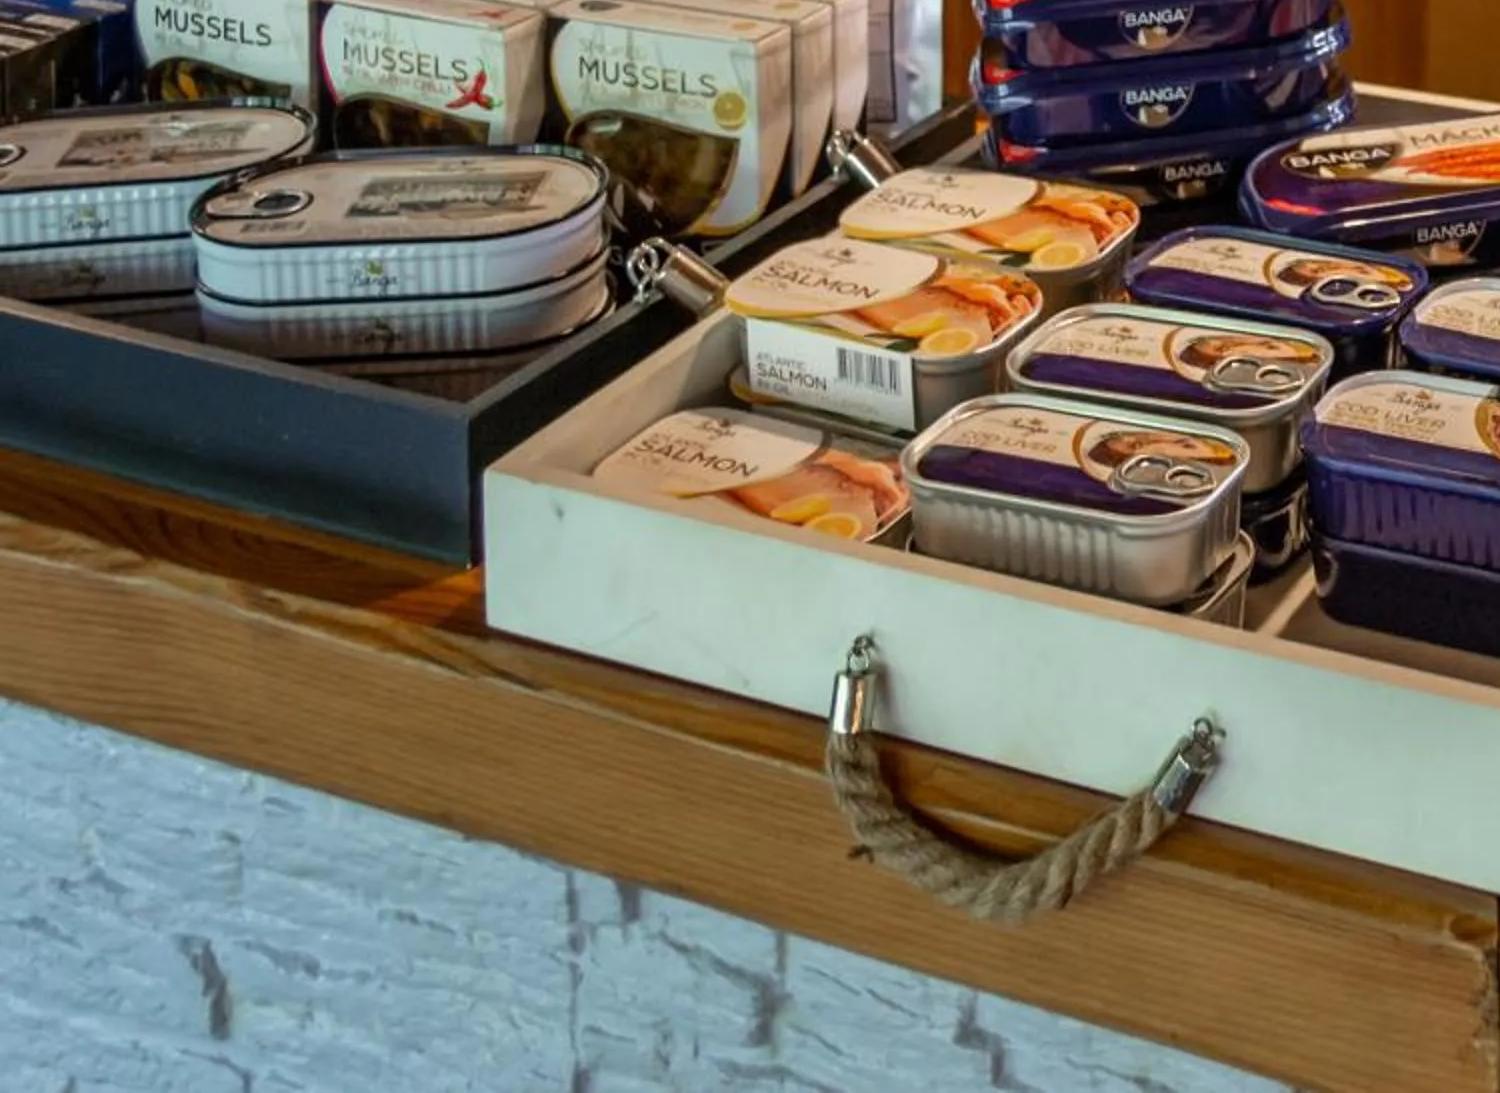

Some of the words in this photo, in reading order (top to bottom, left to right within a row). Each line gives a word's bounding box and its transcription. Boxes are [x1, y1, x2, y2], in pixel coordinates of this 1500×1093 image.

[154, 4, 272, 47] MUSSELS
[1123, 8, 1189, 29] BANGA
[342, 37, 470, 83] MUSSELS
[578, 54, 719, 99] MUSSELS
[1124, 85, 1190, 106] BANGA
[1163, 160, 1226, 183] BANGA
[1289, 146, 1392, 169] BANGA
[871, 191, 987, 220] SALMON
[1415, 222, 1481, 245] BANGA
[761, 266, 881, 300] SALMON
[756, 361, 828, 392] SALMON
[632, 438, 762, 479] SALMON
